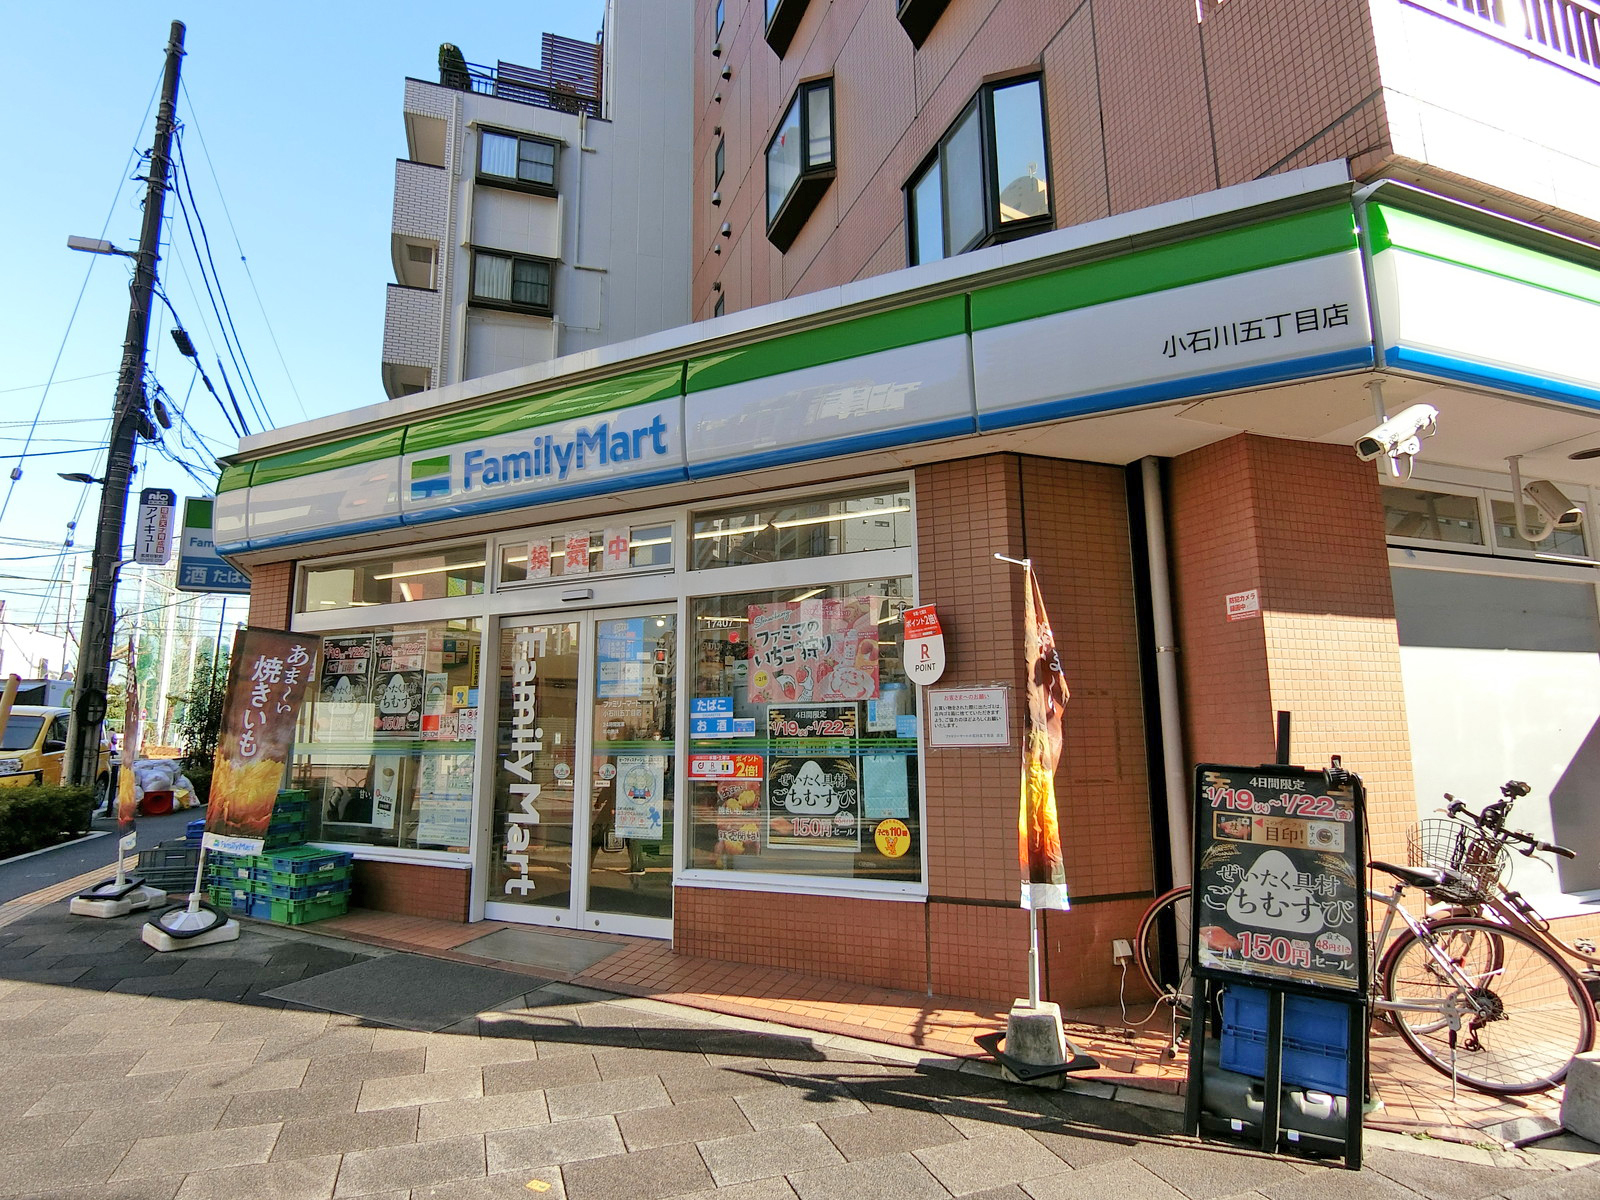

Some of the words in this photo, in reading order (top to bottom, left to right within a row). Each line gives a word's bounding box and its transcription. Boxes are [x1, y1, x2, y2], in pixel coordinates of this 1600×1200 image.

[1163, 303, 1349, 358] 小石川五丁目店
[464, 414, 667, 490] FamilyMart
[144, 506, 158, 553] アイキュー
[531, 536, 628, 570] 換気中
[185, 566, 208, 585] 酒
[706, 619, 734, 629] 17407
[756, 620, 820, 647] ファミマの
[755, 634, 832, 667] いちご狩り
[921, 643, 931, 659] R
[915, 663, 936, 672] POINT
[240, 655, 283, 757] 焼きいも
[603, 700, 640, 708] ファミリーマート
[697, 699, 727, 711] たばこ
[603, 709, 642, 717] 小石川五丁目店
[795, 710, 828, 719] 4日間限定
[697, 720, 727, 732] お酒
[504, 632, 546, 896] FamilyMart
[736, 761, 759, 777] 2倍!
[777, 773, 848, 788] ぜいたく具材
[1249, 777, 1306, 792] 4日間限定
[771, 788, 856, 809] ごちむすび
[791, 818, 832, 837] 150円
[832, 826, 855, 836] セール
[1266, 827, 1303, 843] 目印!
[220, 840, 255, 851] FamilyMart
[1216, 865, 1340, 896] ぜいたく具材
[1203, 885, 1354, 928] ごちむすび
[1326, 932, 1341, 941] 最大
[1237, 931, 1311, 968] 150円
[1312, 955, 1355, 971] セール
[1315, 940, 1351, 953] 48円引き
